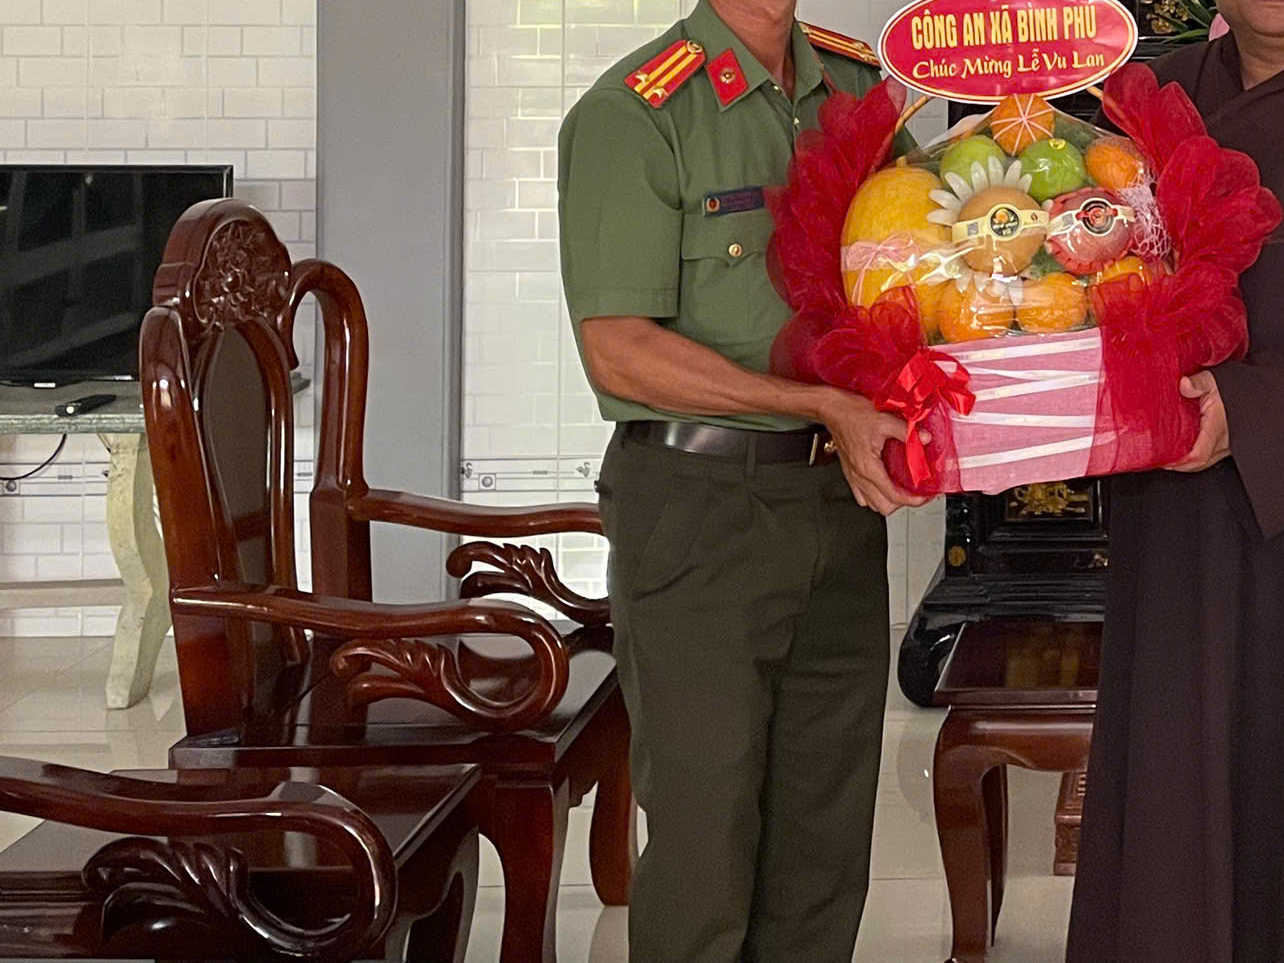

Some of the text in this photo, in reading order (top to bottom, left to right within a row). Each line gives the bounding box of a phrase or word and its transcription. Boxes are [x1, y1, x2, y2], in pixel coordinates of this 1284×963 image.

[911, 8, 958, 50] CÔNG
[963, 12, 986, 47] AN
[989, 4, 1013, 45] XÃ
[1016, 2, 1058, 42] BÌNH
[912, 58, 957, 79] Chúc
[1017, 48, 1041, 72] Lễ
[1041, 51, 1067, 71] Vu
[1072, 50, 1105, 69] Lan
